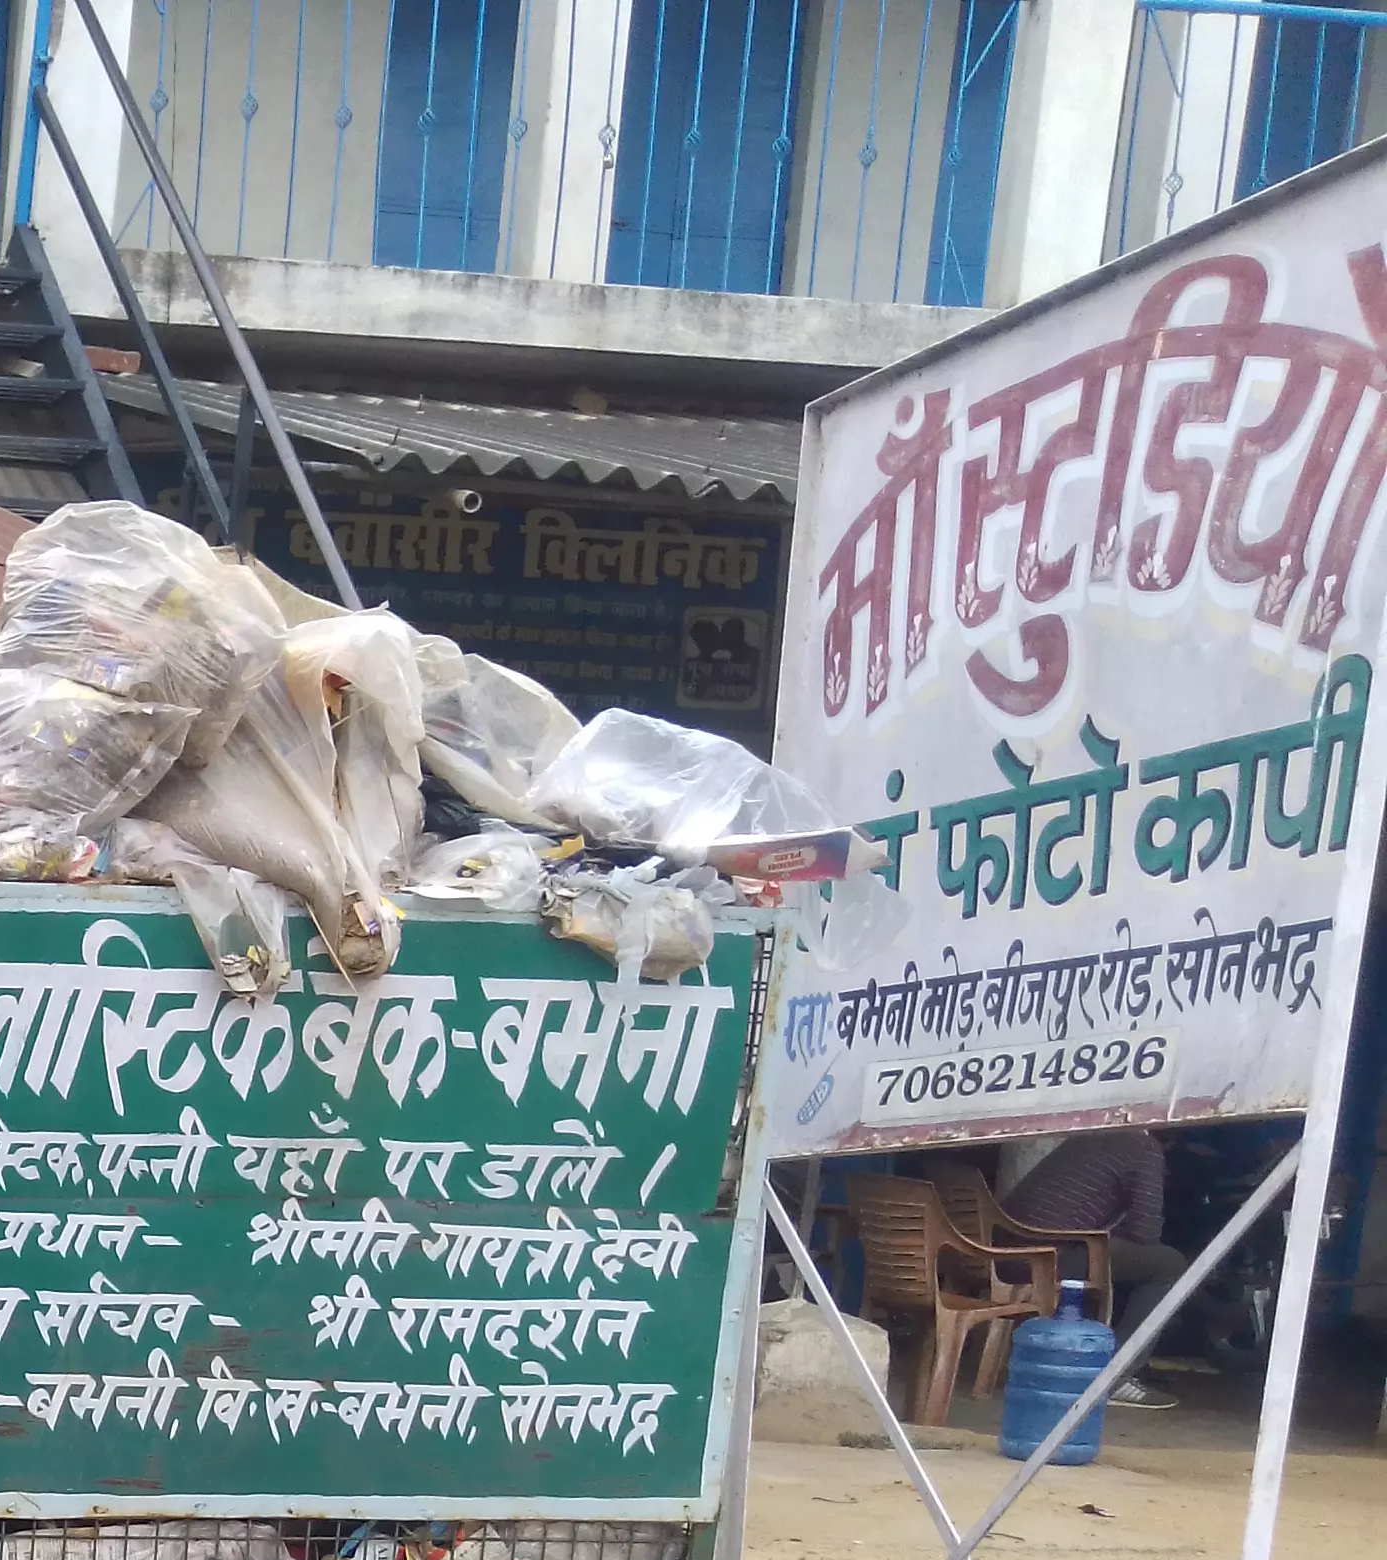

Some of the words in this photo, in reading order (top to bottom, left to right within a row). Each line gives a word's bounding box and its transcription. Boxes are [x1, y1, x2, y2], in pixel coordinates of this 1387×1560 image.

[1135, 653, 1375, 884] कापी
[835, 959, 923, 1050] बभनी
[1166, 906, 1333, 1015] सोनभद्र
[875, 1035, 1168, 1107] 7068214826
[91, 1105, 223, 1197] पन्नी
[377, 1136, 475, 1202] पर
[466, 1117, 626, 1206] डालें
[420, 1205, 596, 1289] गायत्री
[591, 1207, 700, 1284] देवी
[307, 1274, 383, 1350] श्री
[387, 1276, 656, 1362] रामदर्शन
[498, 1361, 679, 1458] सोनभद्र
